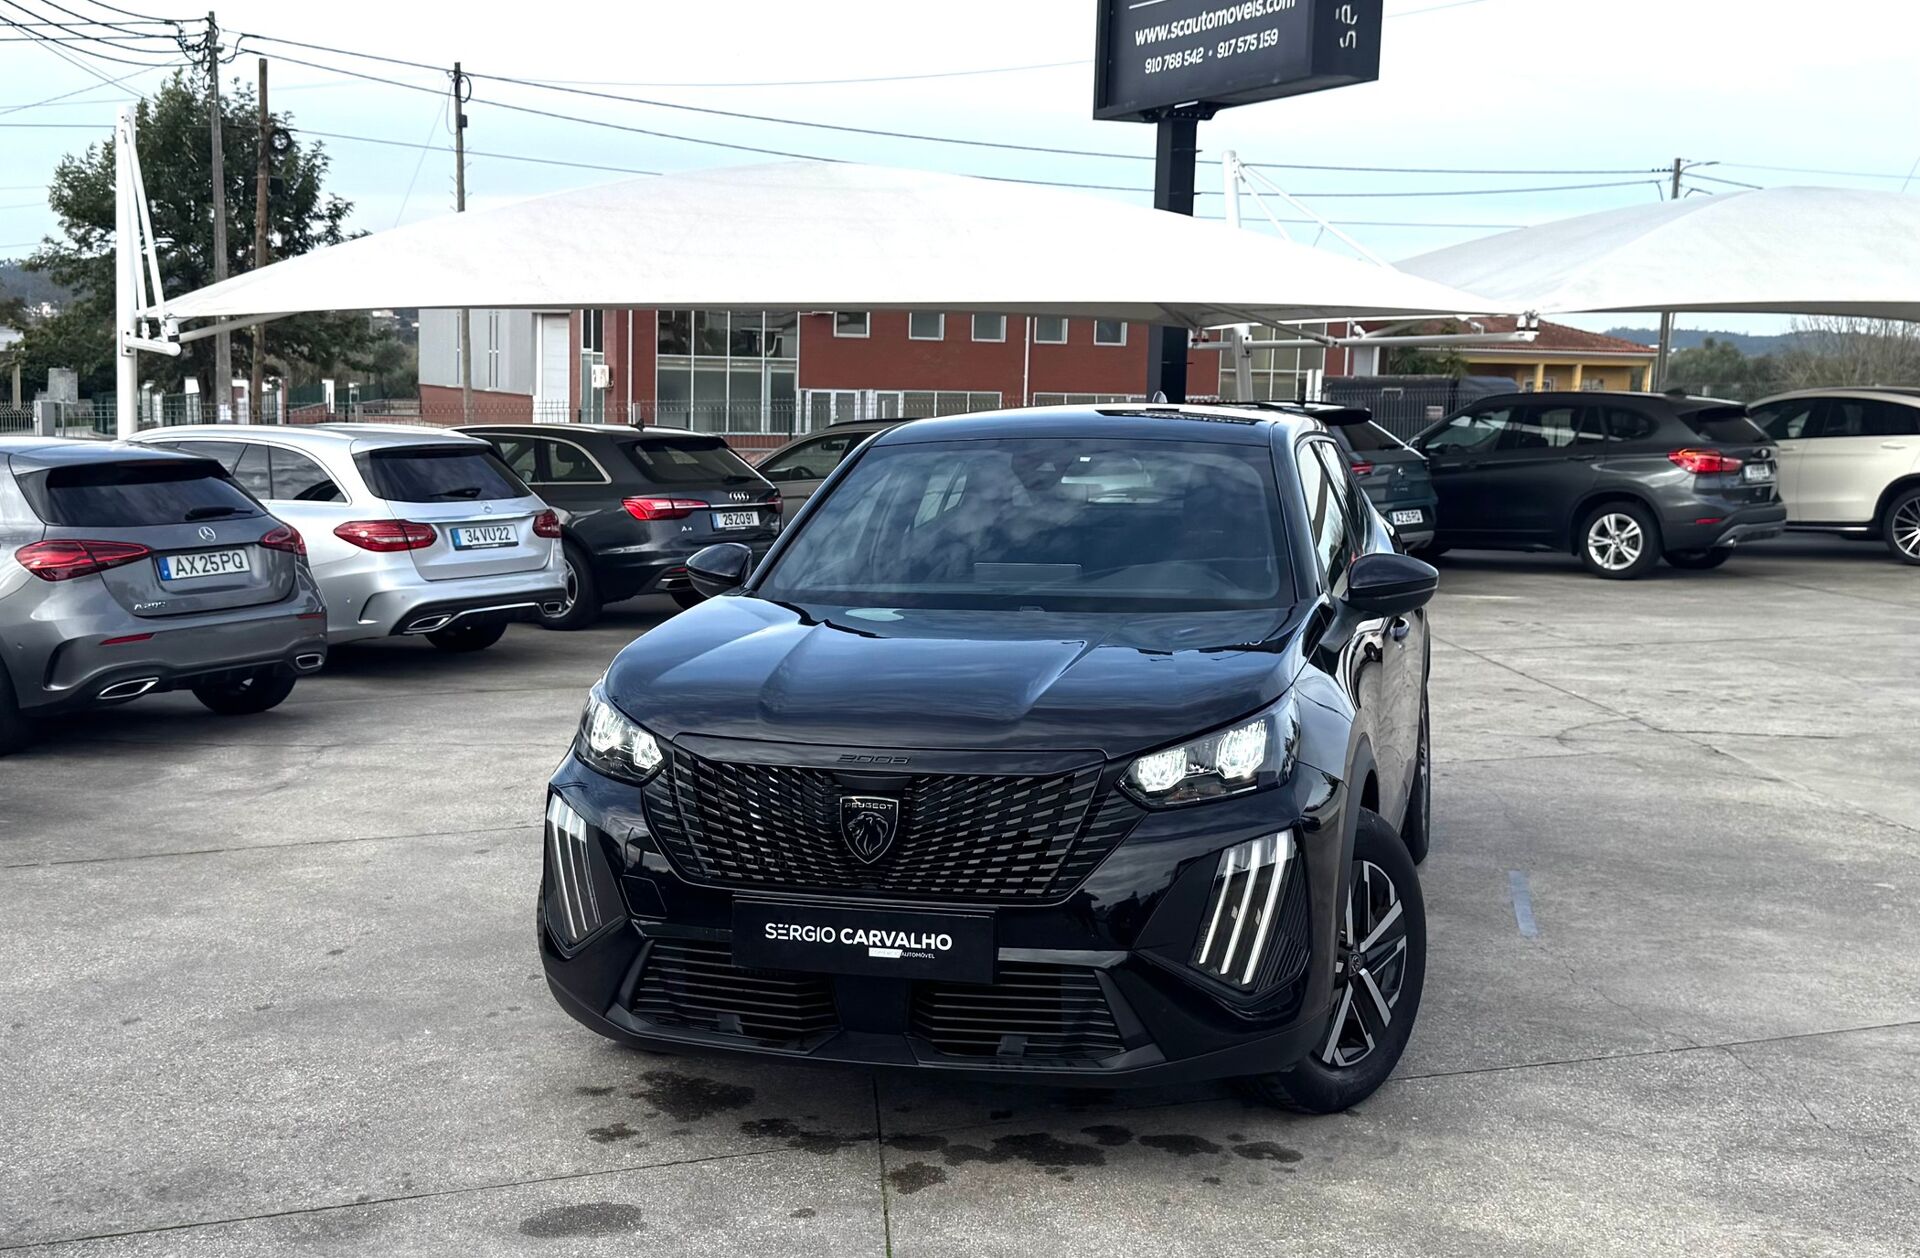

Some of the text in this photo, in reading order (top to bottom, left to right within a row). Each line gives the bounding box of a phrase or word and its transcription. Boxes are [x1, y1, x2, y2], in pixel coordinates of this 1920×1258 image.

[1135, 0, 1296, 46] www.scautomoveis.com
[1145, 28, 1279, 74] 910 768 542 917 575 159
[837, 754, 912, 765] 2008
[844, 802, 894, 810] PEUGEOT
[839, 928, 953, 951] CARVALHO
